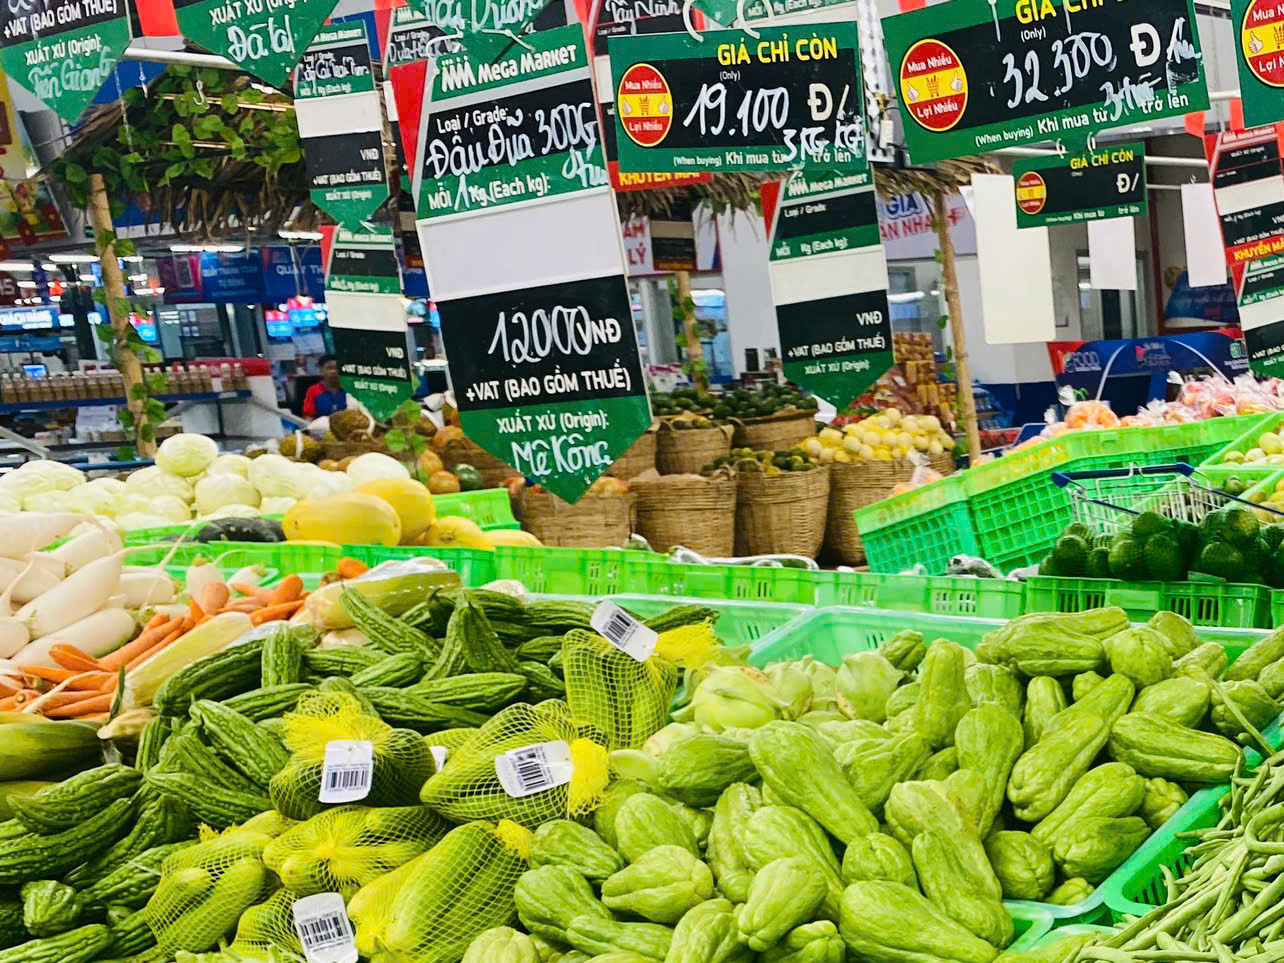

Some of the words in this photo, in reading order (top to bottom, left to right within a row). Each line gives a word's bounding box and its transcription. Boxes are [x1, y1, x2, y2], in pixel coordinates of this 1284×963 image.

[1253, 8, 1275, 22] Mua
[1021, 26, 1047, 41] (Only)
[717, 37, 751, 66] GIÁ
[757, 33, 790, 63] CHỈ
[796, 32, 838, 62] CÒN
[907, 60, 927, 74] Mua
[926, 54, 953, 71] Nhiều
[1258, 58, 1277, 73] Lợi
[683, 82, 789, 136] 19.100
[917, 104, 933, 119] Lợi
[933, 100, 959, 116] Nhiều
[436, 116, 461, 135] Loại
[975, 132, 1002, 148] (When
[1003, 126, 1034, 145] buying)
[1036, 117, 1060, 134] Khi
[1062, 114, 1090, 131] mua
[1093, 107, 1111, 124] từ
[725, 151, 744, 165] Khi
[746, 154, 769, 165] mua
[1112, 148, 1134, 164] CÒN
[856, 310, 883, 326] VNĐ
[466, 380, 500, 402] +VAT
[504, 375, 541, 402] (BAO
[544, 365, 579, 394] GỒM
[581, 358, 631, 391] THUẾ)
[496, 409, 532, 434] XUẤT
[560, 409, 609, 433] (Origin):
